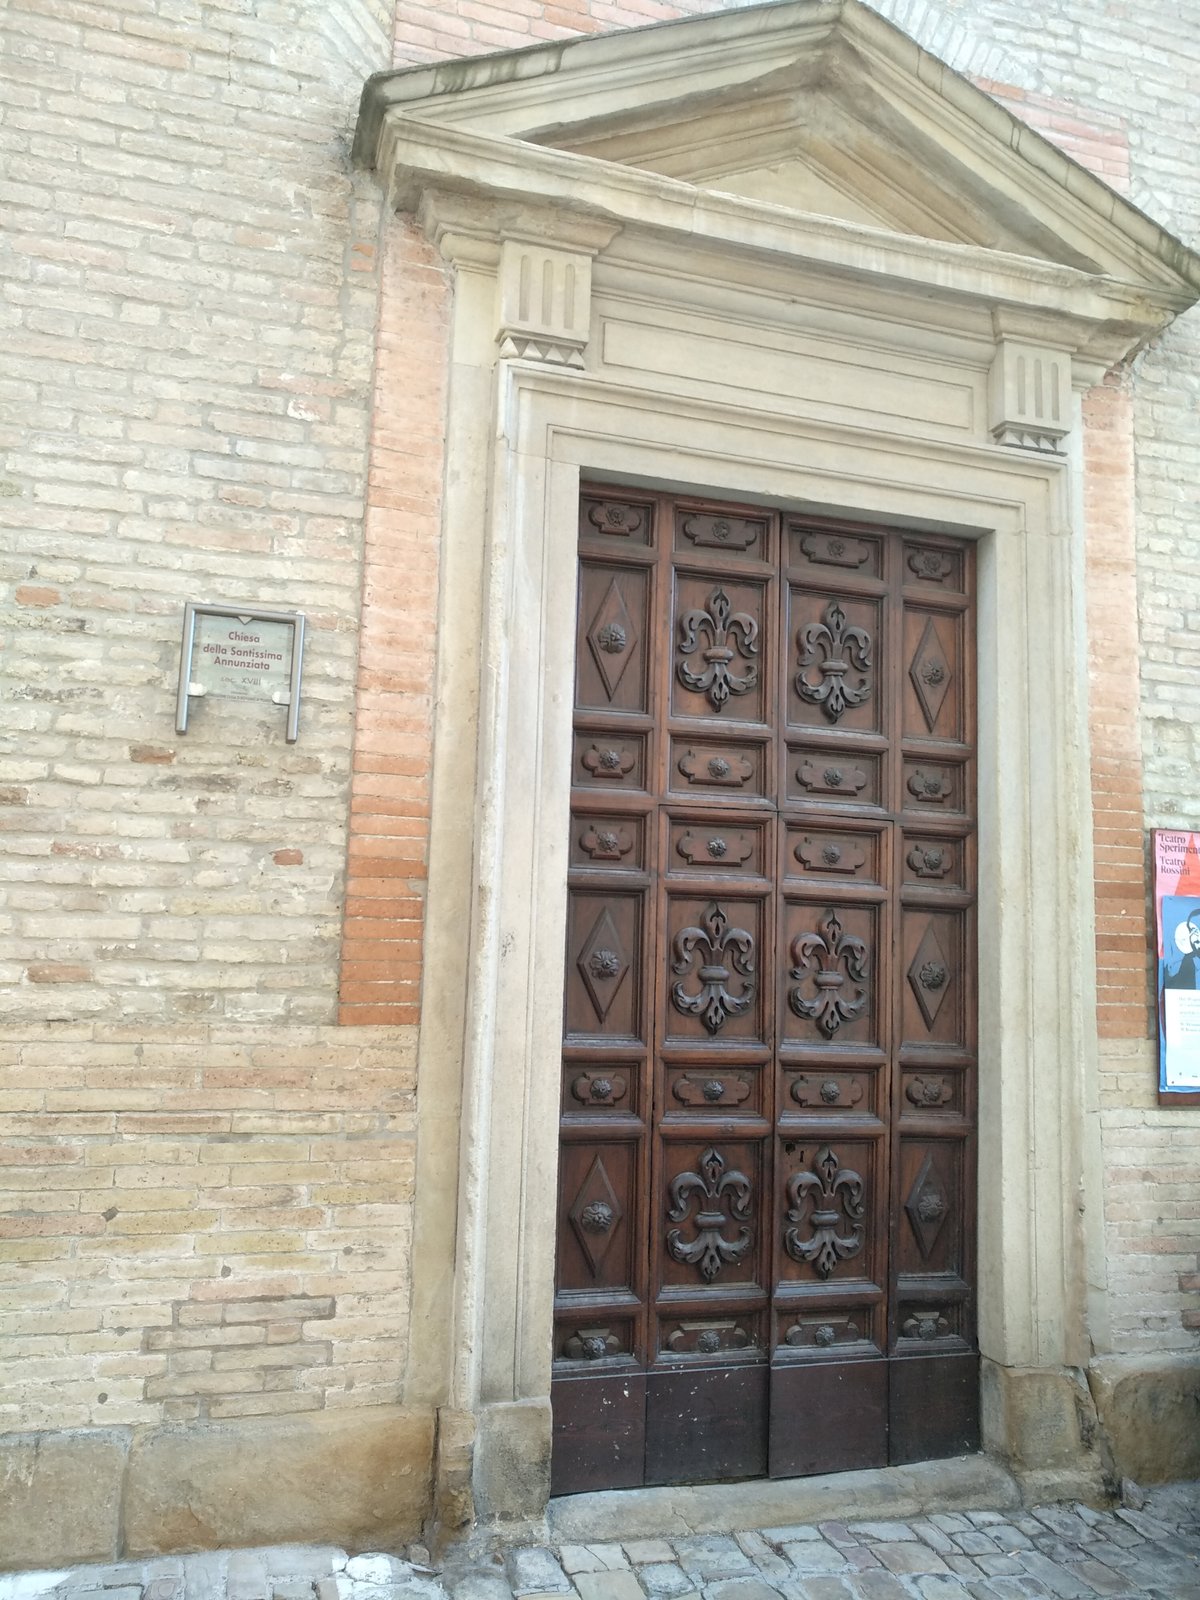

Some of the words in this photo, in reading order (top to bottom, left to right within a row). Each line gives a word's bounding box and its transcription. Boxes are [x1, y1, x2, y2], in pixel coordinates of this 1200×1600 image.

[228, 632, 260, 643] Chiesa
[203, 644, 227, 655] della
[231, 647, 282, 660] Santissima
[214, 656, 270, 670] Annunziata
[1158, 833, 1186, 843] Teatro
[1160, 855, 1186, 866] Teatro
[1161, 865, 1190, 875] Rossini
